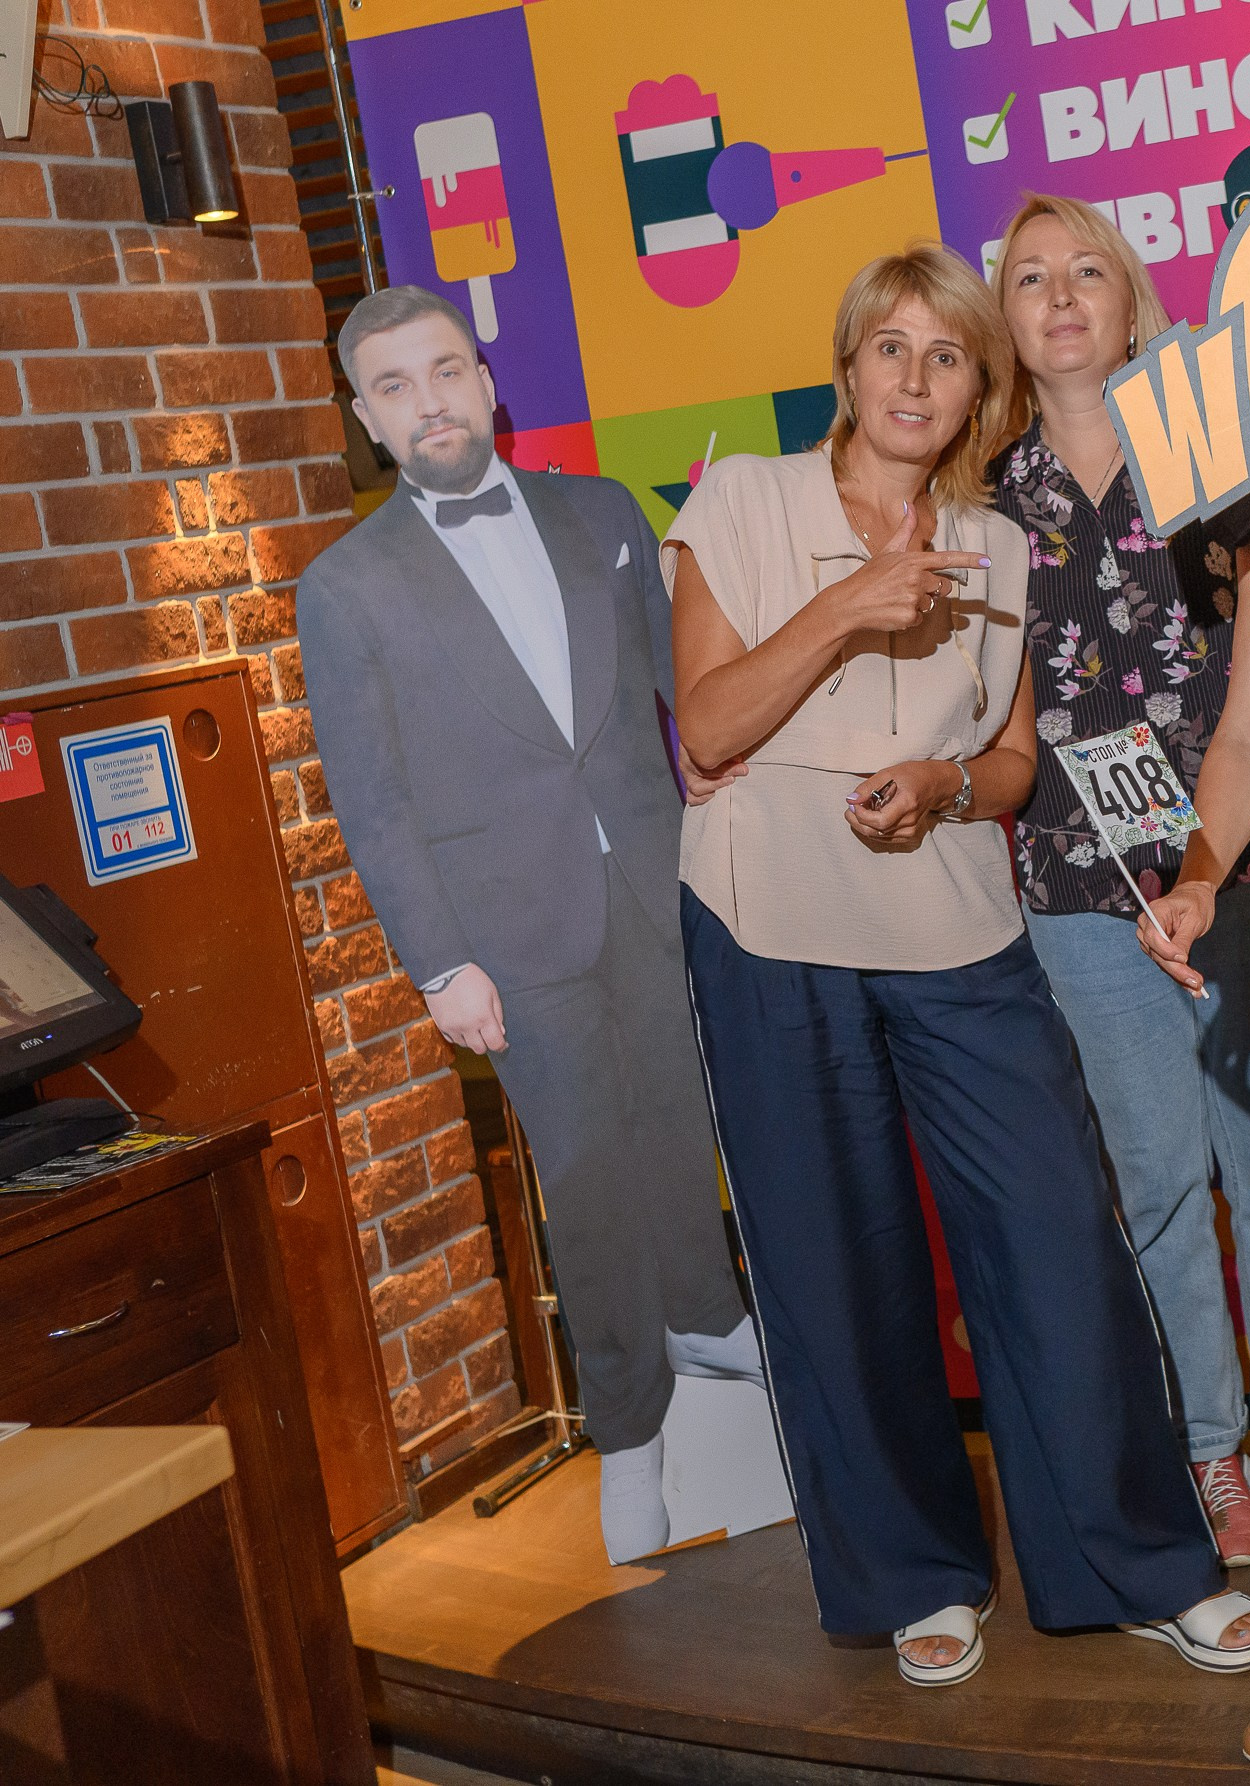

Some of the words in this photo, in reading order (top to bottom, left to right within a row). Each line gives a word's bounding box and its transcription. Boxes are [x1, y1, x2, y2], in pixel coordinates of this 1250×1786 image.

[93, 753, 144, 771] Ответственный
[1087, 744, 1117, 763] СТОЛ
[96, 763, 154, 783] противопожарное
[109, 777, 144, 790] состояние
[1087, 754, 1177, 821] 408
[110, 786, 149, 801] помещения
[111, 830, 132, 852] 01
[144, 821, 165, 838] 112
